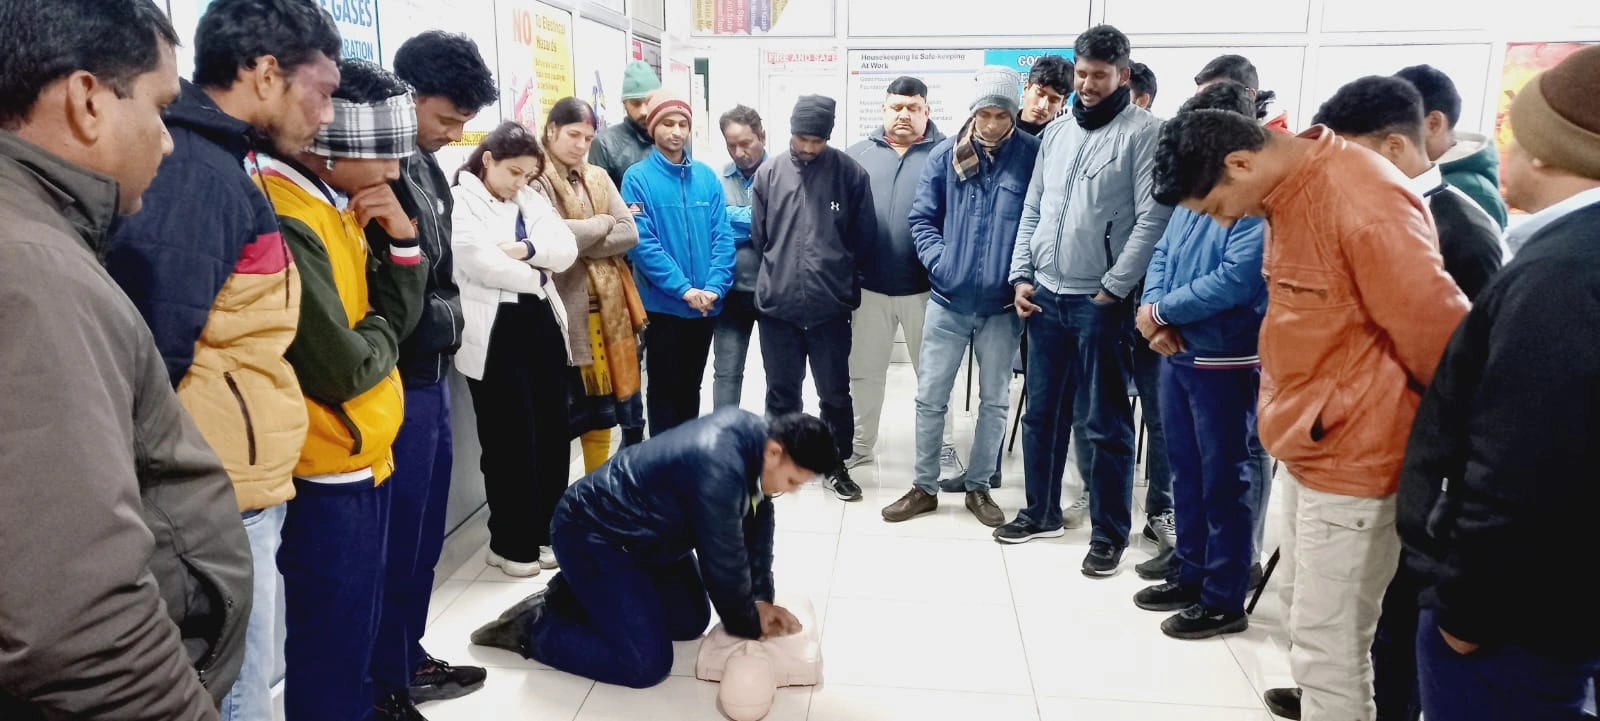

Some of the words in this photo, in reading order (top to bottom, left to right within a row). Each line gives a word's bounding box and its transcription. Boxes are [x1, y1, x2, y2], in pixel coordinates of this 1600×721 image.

[331, 0, 373, 27] GASES
[512, 8, 532, 46] NO
[768, 52, 789, 63] FIRE
[791, 53, 811, 62] AND
[861, 53, 911, 62] Housekeeping
